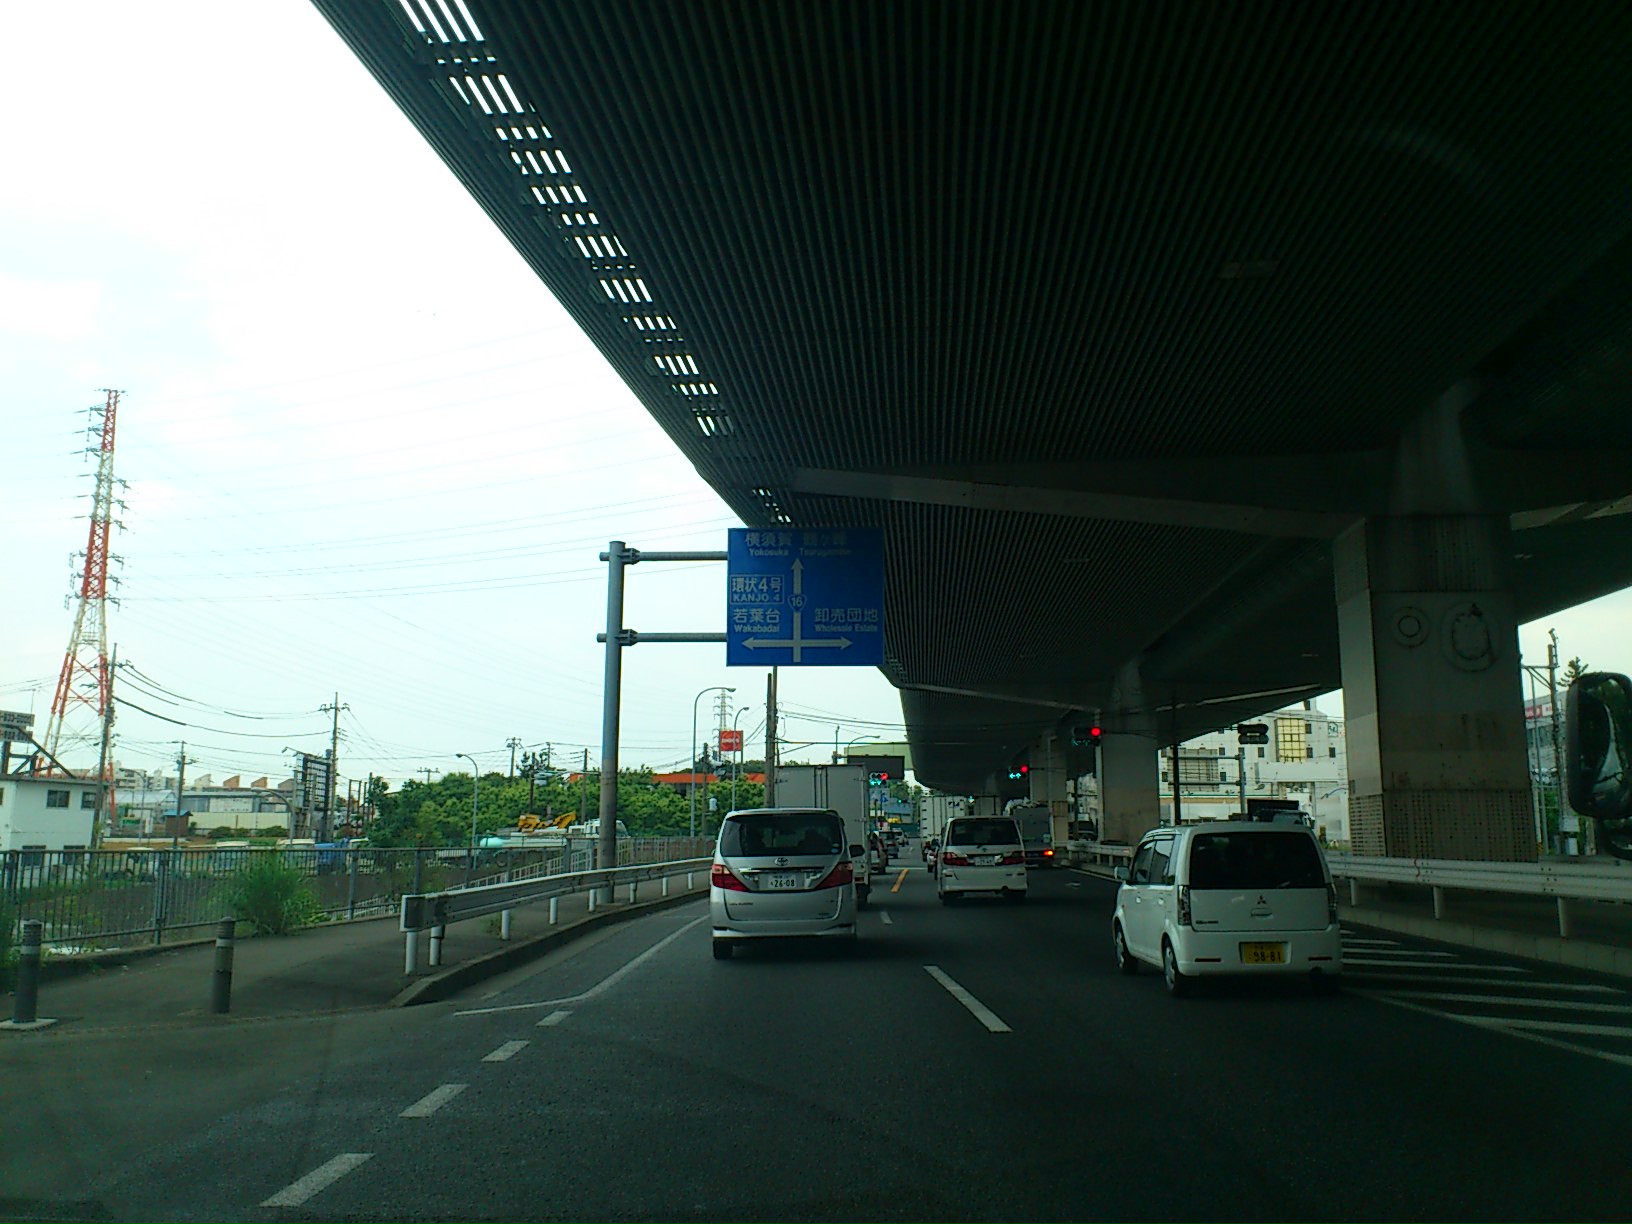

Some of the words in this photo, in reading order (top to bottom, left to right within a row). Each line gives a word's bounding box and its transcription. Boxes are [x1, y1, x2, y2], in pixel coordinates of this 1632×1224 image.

[745, 532, 792, 547] 横須賀
[748, 548, 789, 557] Yokosuka
[732, 577, 782, 592] 環状4号
[733, 593, 769, 602] KANJO
[773, 593, 780, 602] 4
[791, 597, 802, 607] 16
[733, 608, 781, 623] 若葉台
[814, 608, 879, 623] 卸売団地
[734, 624, 780, 633] Wakabadai
[814, 624, 852, 632] Wholesale
[855, 624, 878, 632] Estate
[774, 879, 795, 887] 26-08
